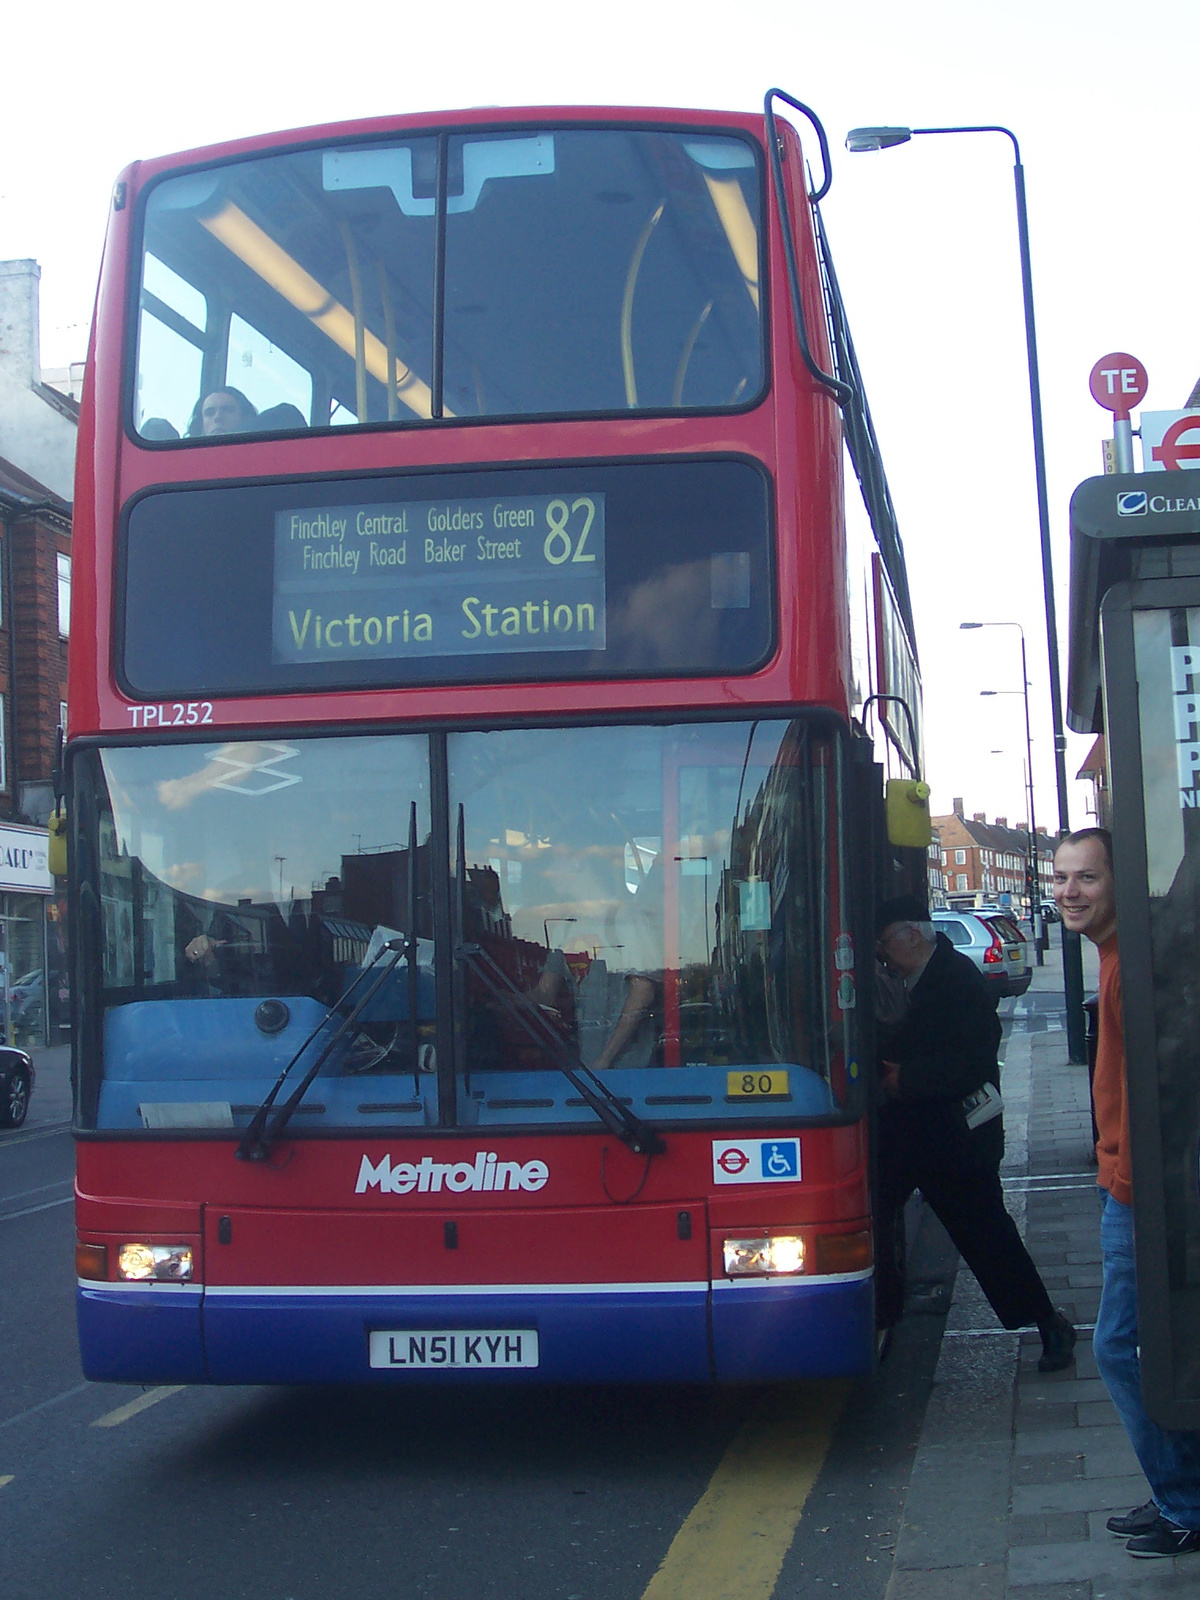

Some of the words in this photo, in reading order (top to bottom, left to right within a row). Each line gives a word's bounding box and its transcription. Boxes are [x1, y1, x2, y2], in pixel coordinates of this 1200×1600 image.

[1100, 369, 1139, 394] TE
[290, 514, 347, 540] Finchley
[356, 511, 408, 536] Central
[427, 508, 484, 531] Golders
[493, 504, 535, 528] Green
[543, 497, 596, 565] 82
[303, 547, 360, 574] Finchley
[369, 541, 406, 565] Road
[424, 539, 466, 563] Baker
[477, 536, 521, 560] Street
[288, 608, 433, 650] Victoria
[461, 596, 596, 639] Station
[127, 702, 214, 728] TPL252
[741, 1074, 772, 1093] 80
[354, 1151, 550, 1194] Metroline
[389, 1336, 455, 1364] LN51
[465, 1336, 522, 1363] KYH
